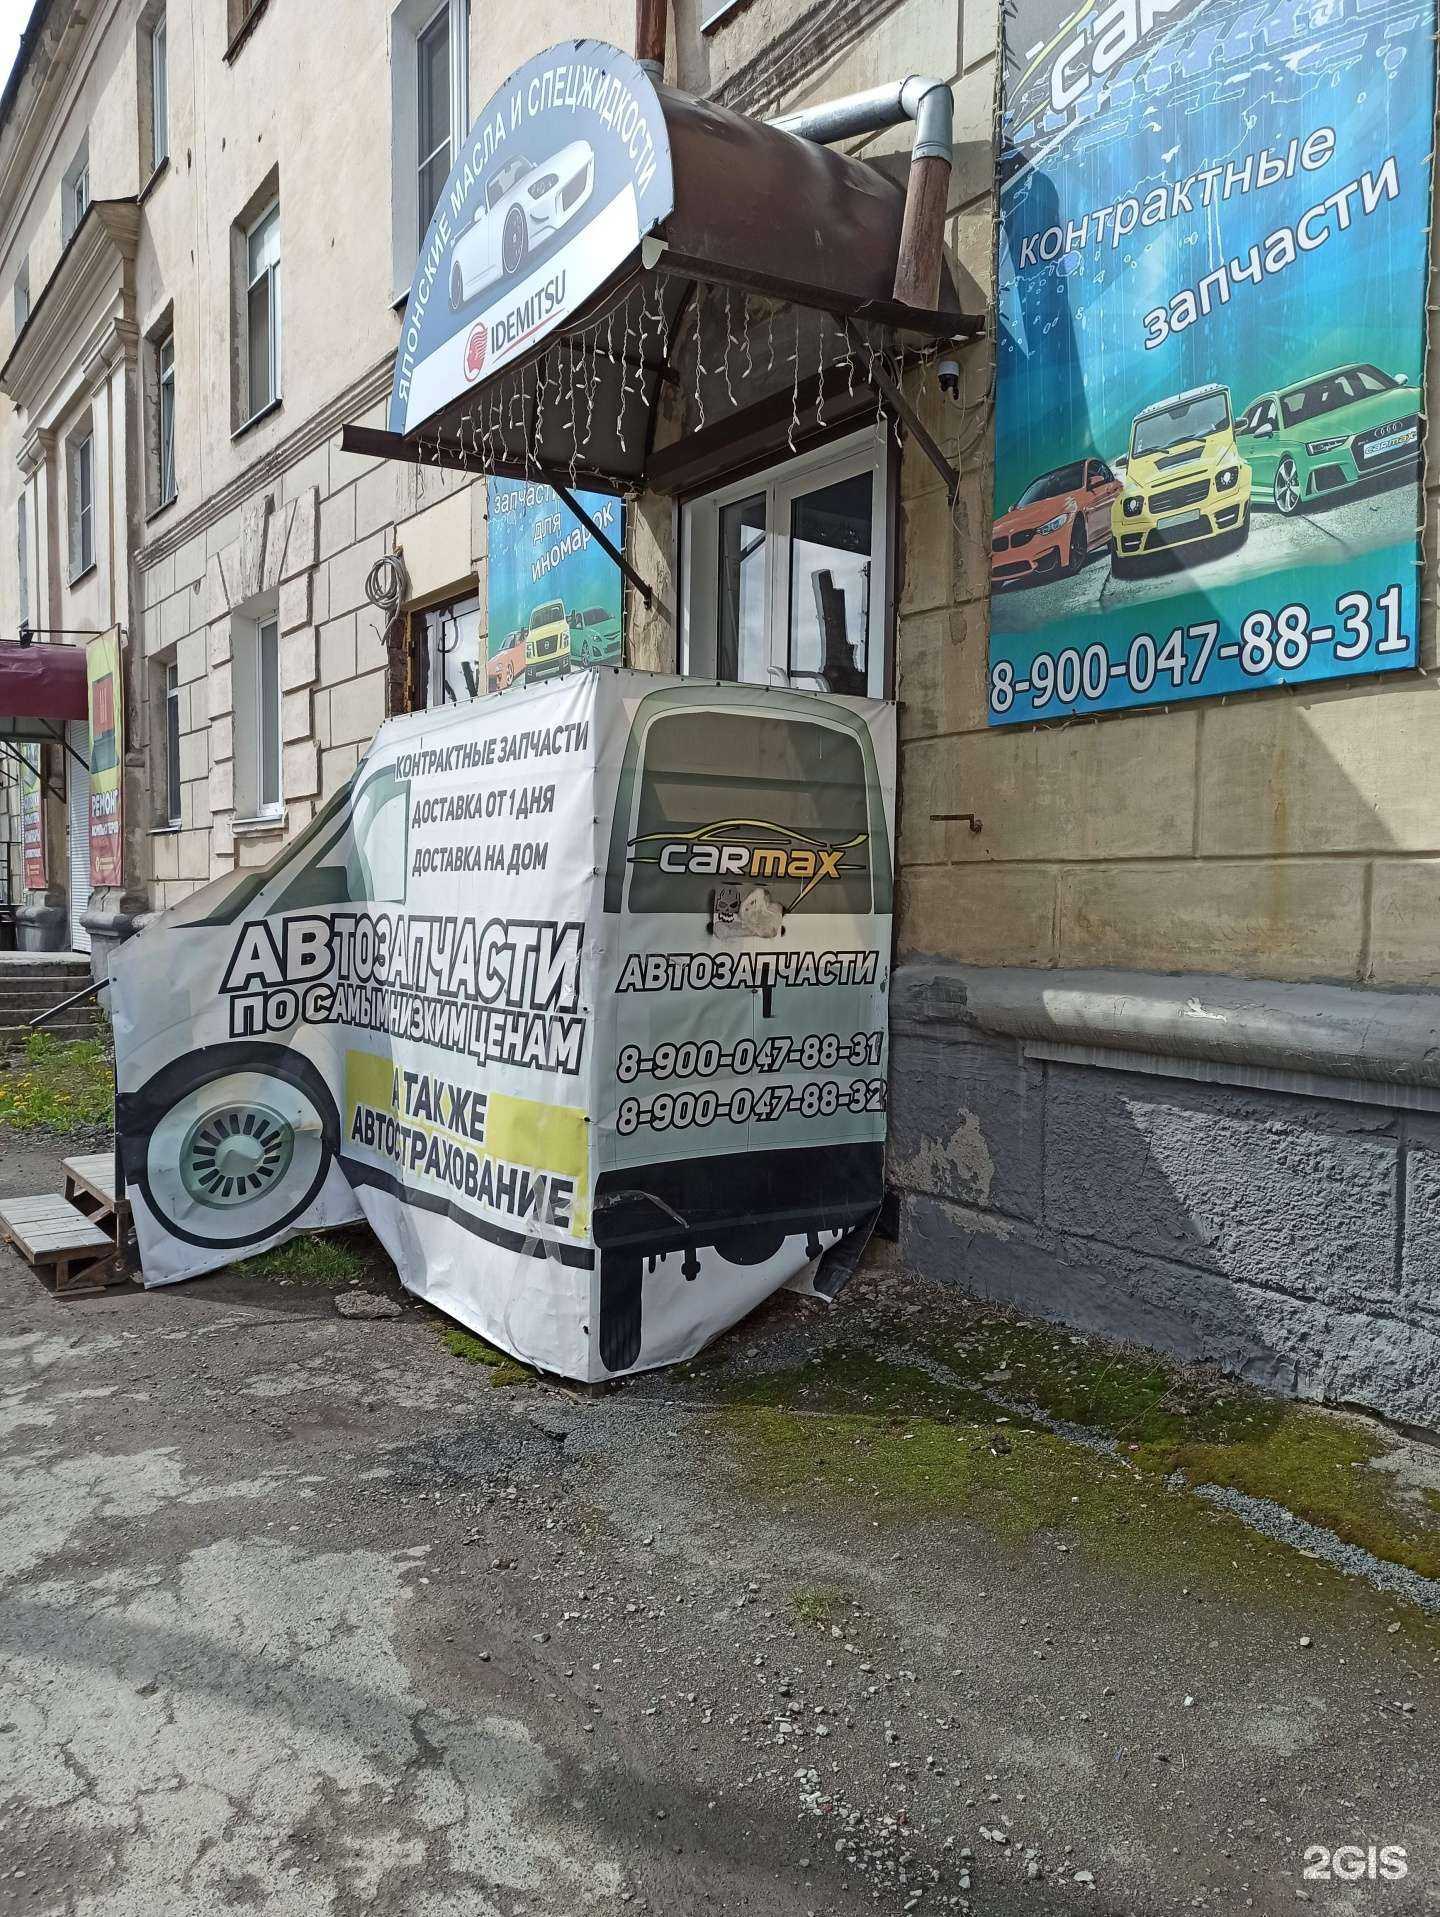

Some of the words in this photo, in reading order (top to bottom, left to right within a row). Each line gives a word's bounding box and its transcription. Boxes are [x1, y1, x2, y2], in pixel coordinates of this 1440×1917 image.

[399, 211, 452, 403] ЯПОНСКИЕ
[450, 112, 507, 218] МАСЛА
[511, 90, 523, 131] И
[528, 64, 657, 198] СПЕЦЖИДКОСТИ
[1019, 126, 1337, 270] контрактные
[1143, 155, 1401, 351] запчасти
[491, 269, 566, 354] IDEMITSU
[533, 512, 561, 546] для
[990, 584, 1409, 714] 8-900-047-88-31
[396, 738, 497, 779] КОНТРАКТНЫЕ
[497, 720, 589, 763] ЗАПЧАСТИ
[412, 793, 482, 829] ДОСТАВКА
[485, 789, 508, 818] ОТ
[509, 788, 515, 816] 1
[516, 784, 556, 820] ДНЯ
[412, 845, 481, 877] ДОСТАВКА
[484, 844, 505, 871] НА
[506, 842, 549, 876] ДОМ
[218, 912, 585, 1015] АВТОЗАПЧАСТИ
[615, 950, 881, 994] АВТОЗАПЧАСТИ
[229, 988, 299, 1039] ПО
[301, 982, 390, 1034] САМЫМ
[389, 990, 466, 1054] НИЗКИМ
[467, 1003, 586, 1076] ЦЕНАМ
[616, 1031, 884, 1084] 8-900-047-88-31
[392, 1067, 400, 1110] А
[616, 1077, 888, 1136] 8-900-047-88-32
[351, 1105, 575, 1229] АВТОСТРАХОВАНИЕ
